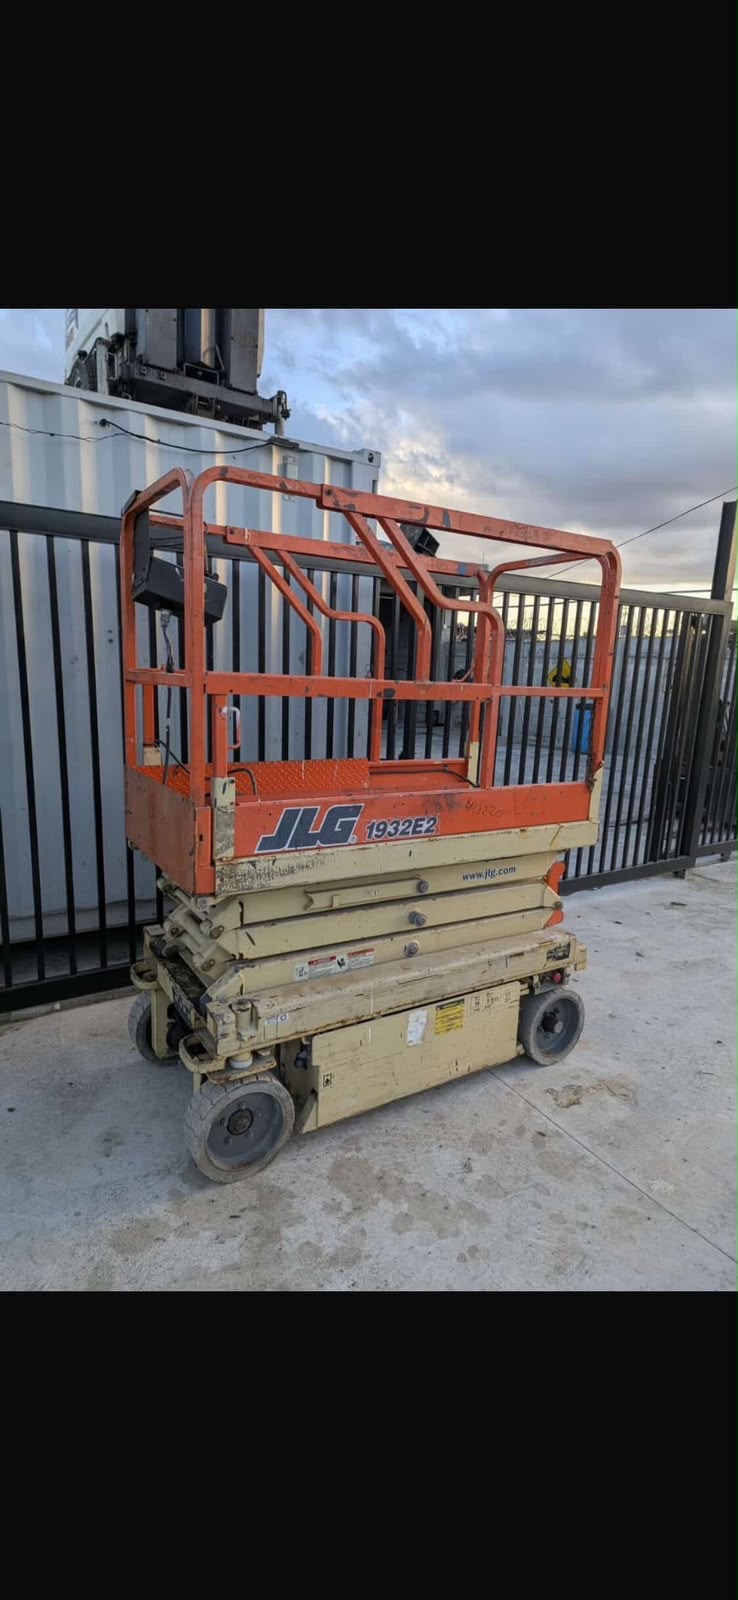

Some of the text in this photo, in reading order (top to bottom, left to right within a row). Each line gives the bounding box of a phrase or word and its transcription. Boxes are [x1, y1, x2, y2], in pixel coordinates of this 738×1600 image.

[255, 803, 438, 853] JLG 1932E2
[462, 866, 516, 880] www.jlg.com
